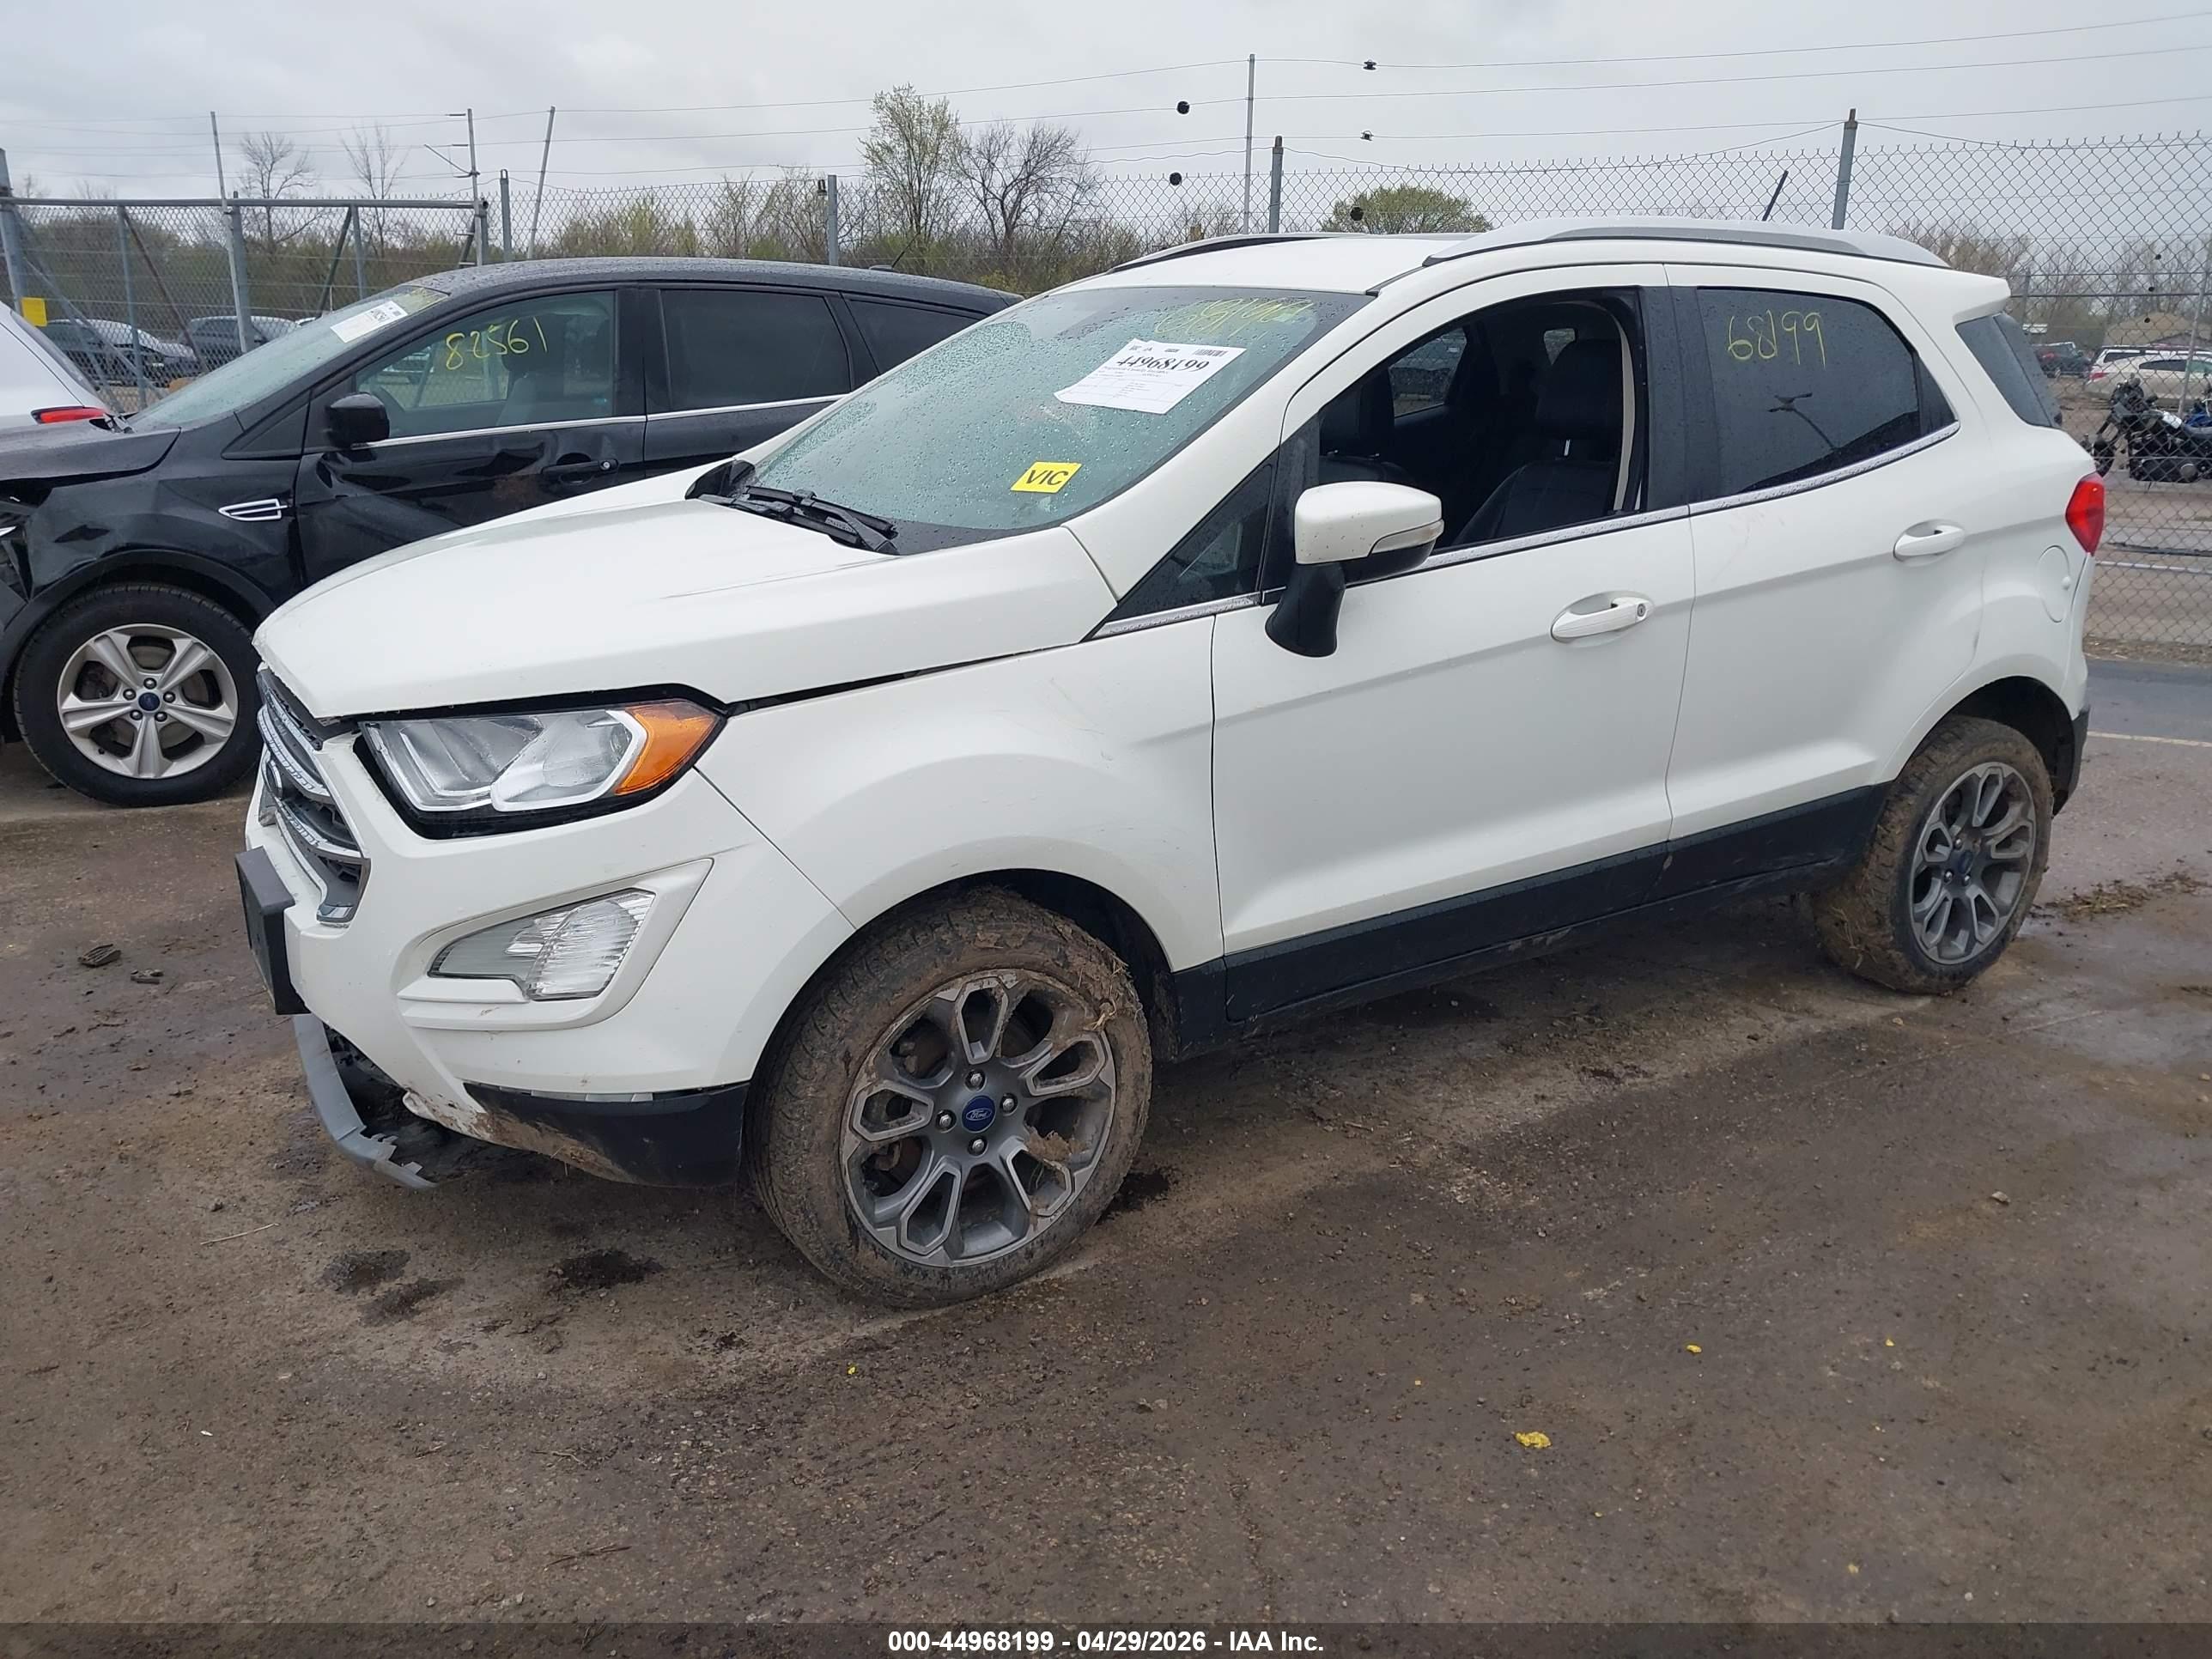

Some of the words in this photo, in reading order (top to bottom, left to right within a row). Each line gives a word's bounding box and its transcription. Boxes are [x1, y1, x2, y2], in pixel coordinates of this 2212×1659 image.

[446, 316, 548, 370] 82561
[1727, 308, 1826, 369] 68199
[1116, 355, 1210, 373] 44968199
[1026, 469, 1069, 486] VIC
